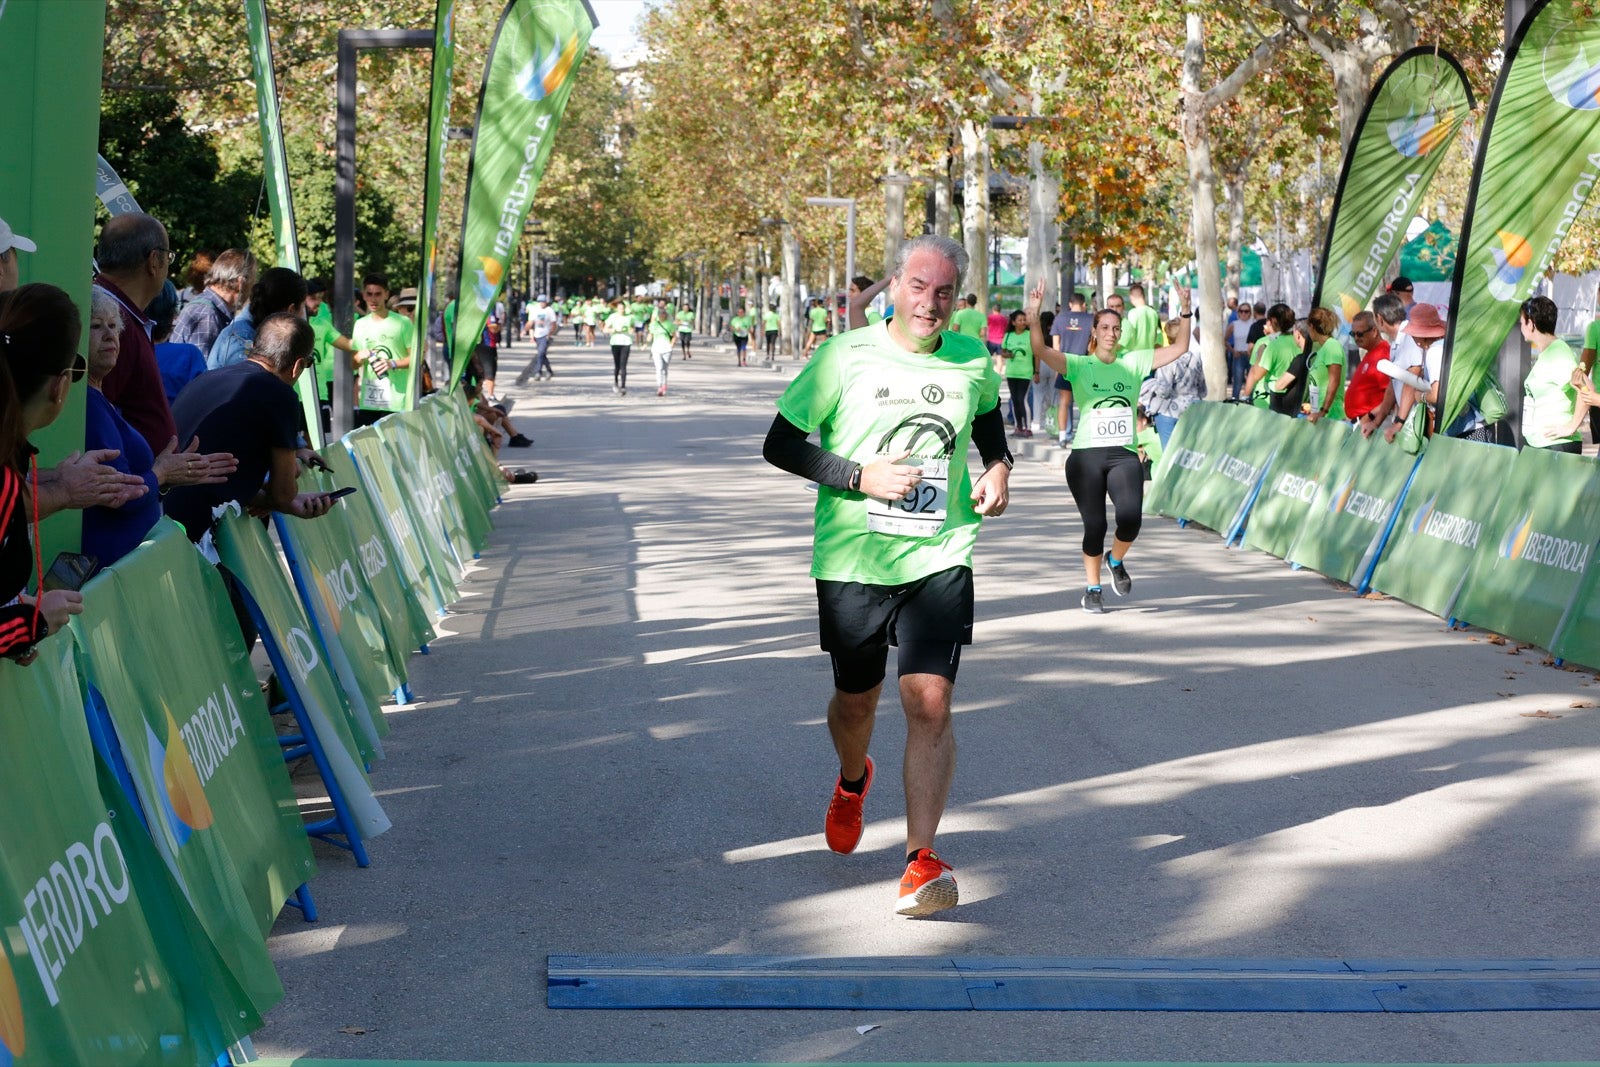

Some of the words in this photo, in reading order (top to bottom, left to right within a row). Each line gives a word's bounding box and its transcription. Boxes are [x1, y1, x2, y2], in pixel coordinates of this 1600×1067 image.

[1353, 173, 1421, 299] IBERDROLA
[1097, 420, 1127, 436] 606
[1424, 509, 1482, 549] IBERDROLA
[1521, 531, 1590, 574] IBERDROLA
[179, 682, 246, 788] RDROLA
